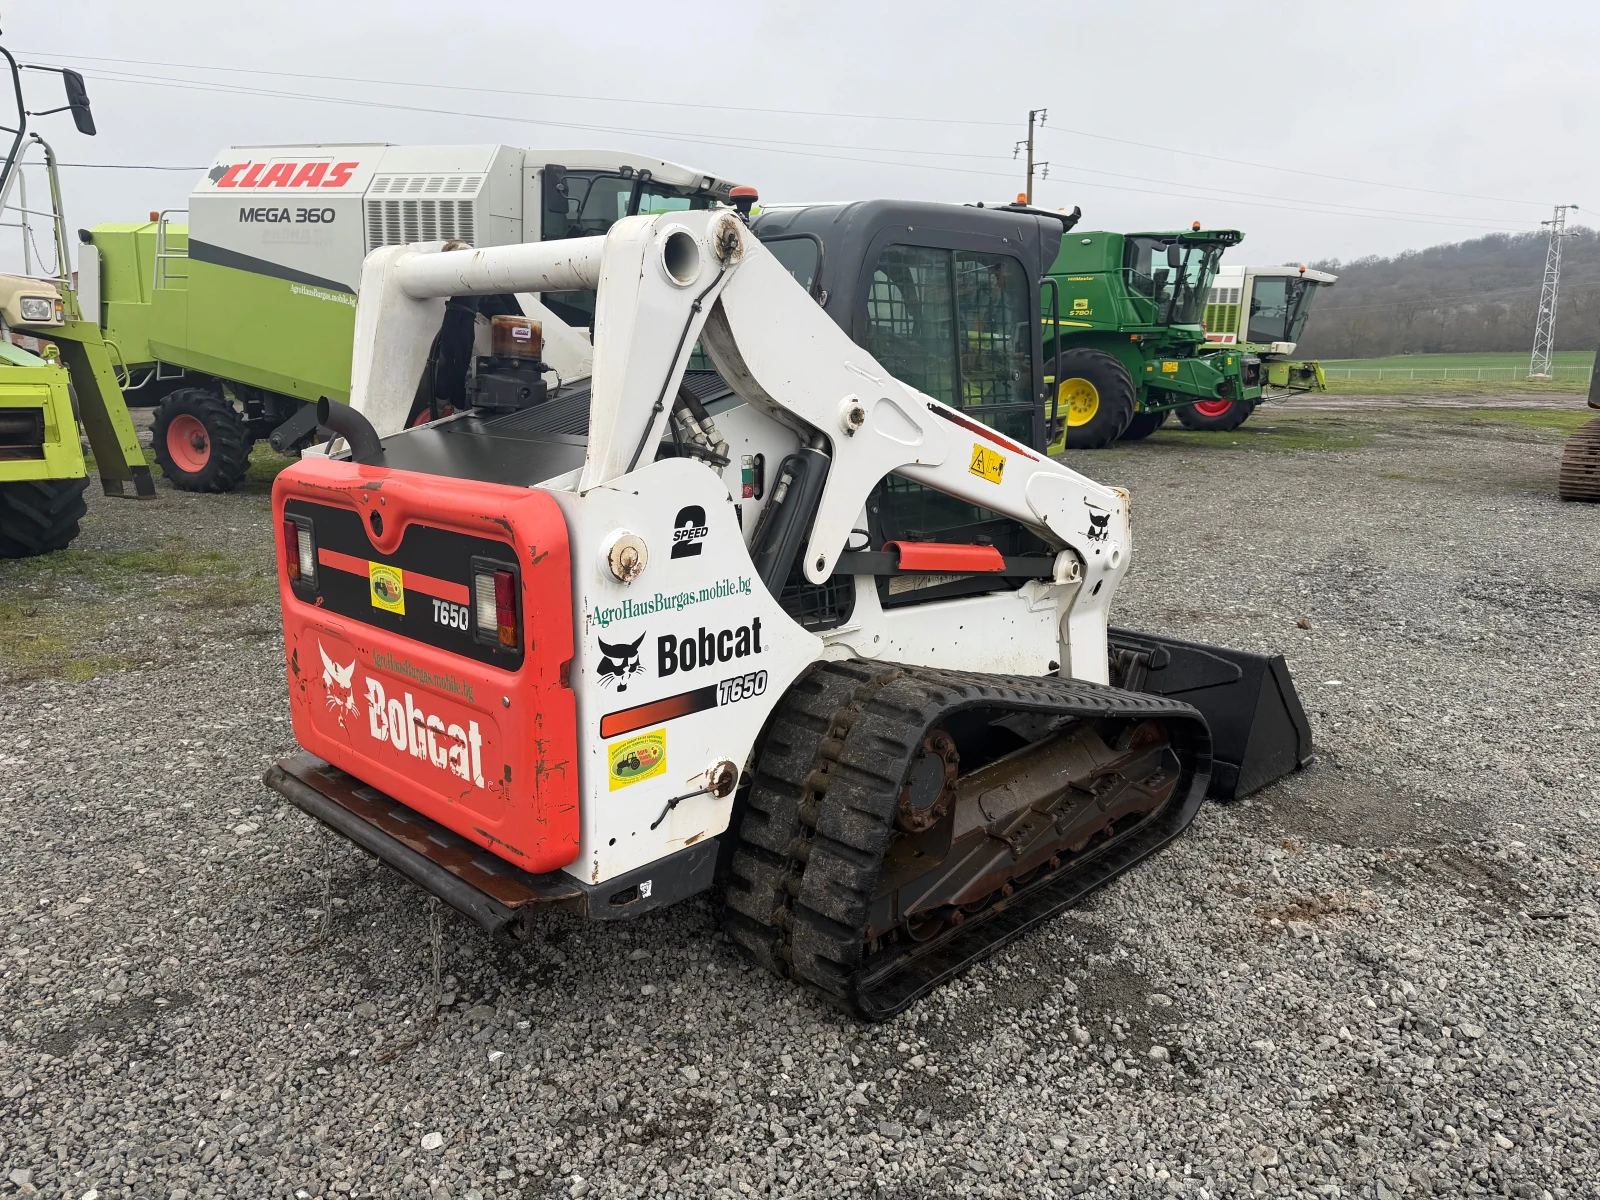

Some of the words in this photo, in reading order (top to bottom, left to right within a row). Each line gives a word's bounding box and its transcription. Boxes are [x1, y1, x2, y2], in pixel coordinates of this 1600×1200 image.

[217, 161, 360, 188] CLAAS
[239, 208, 291, 223] MEGA
[295, 207, 336, 223] 360
[672, 526, 709, 542] SPEED
[432, 599, 469, 631] T650
[592, 576, 752, 630] AgroHausBurgas.mobile.bg
[658, 617, 762, 678] Bobcat
[372, 647, 475, 703] AgroHausBurgas.mobile.bg
[719, 670, 768, 706] T650
[364, 676, 485, 789] Bobcat
